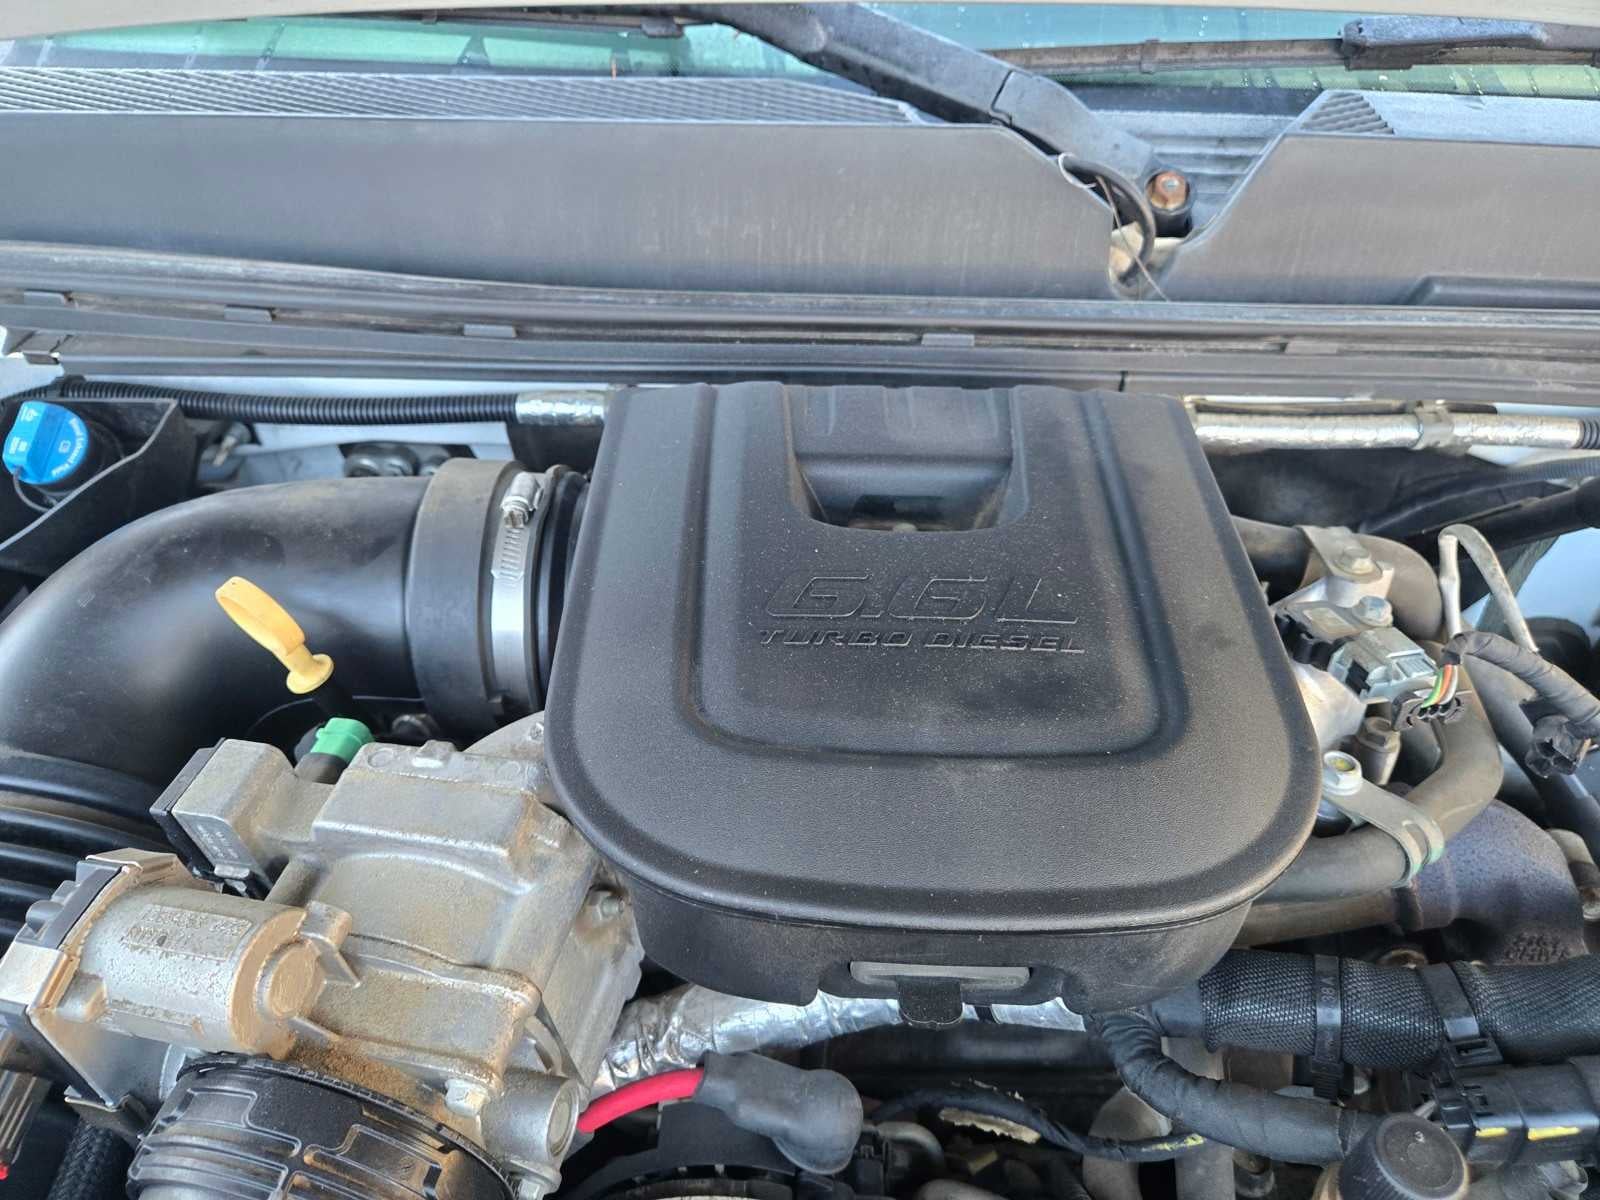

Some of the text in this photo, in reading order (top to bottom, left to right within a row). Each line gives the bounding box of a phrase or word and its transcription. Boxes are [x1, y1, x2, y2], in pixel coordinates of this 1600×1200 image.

[766, 571, 1079, 624] 6.6L
[760, 630, 1085, 654] TURBO DIESEL
